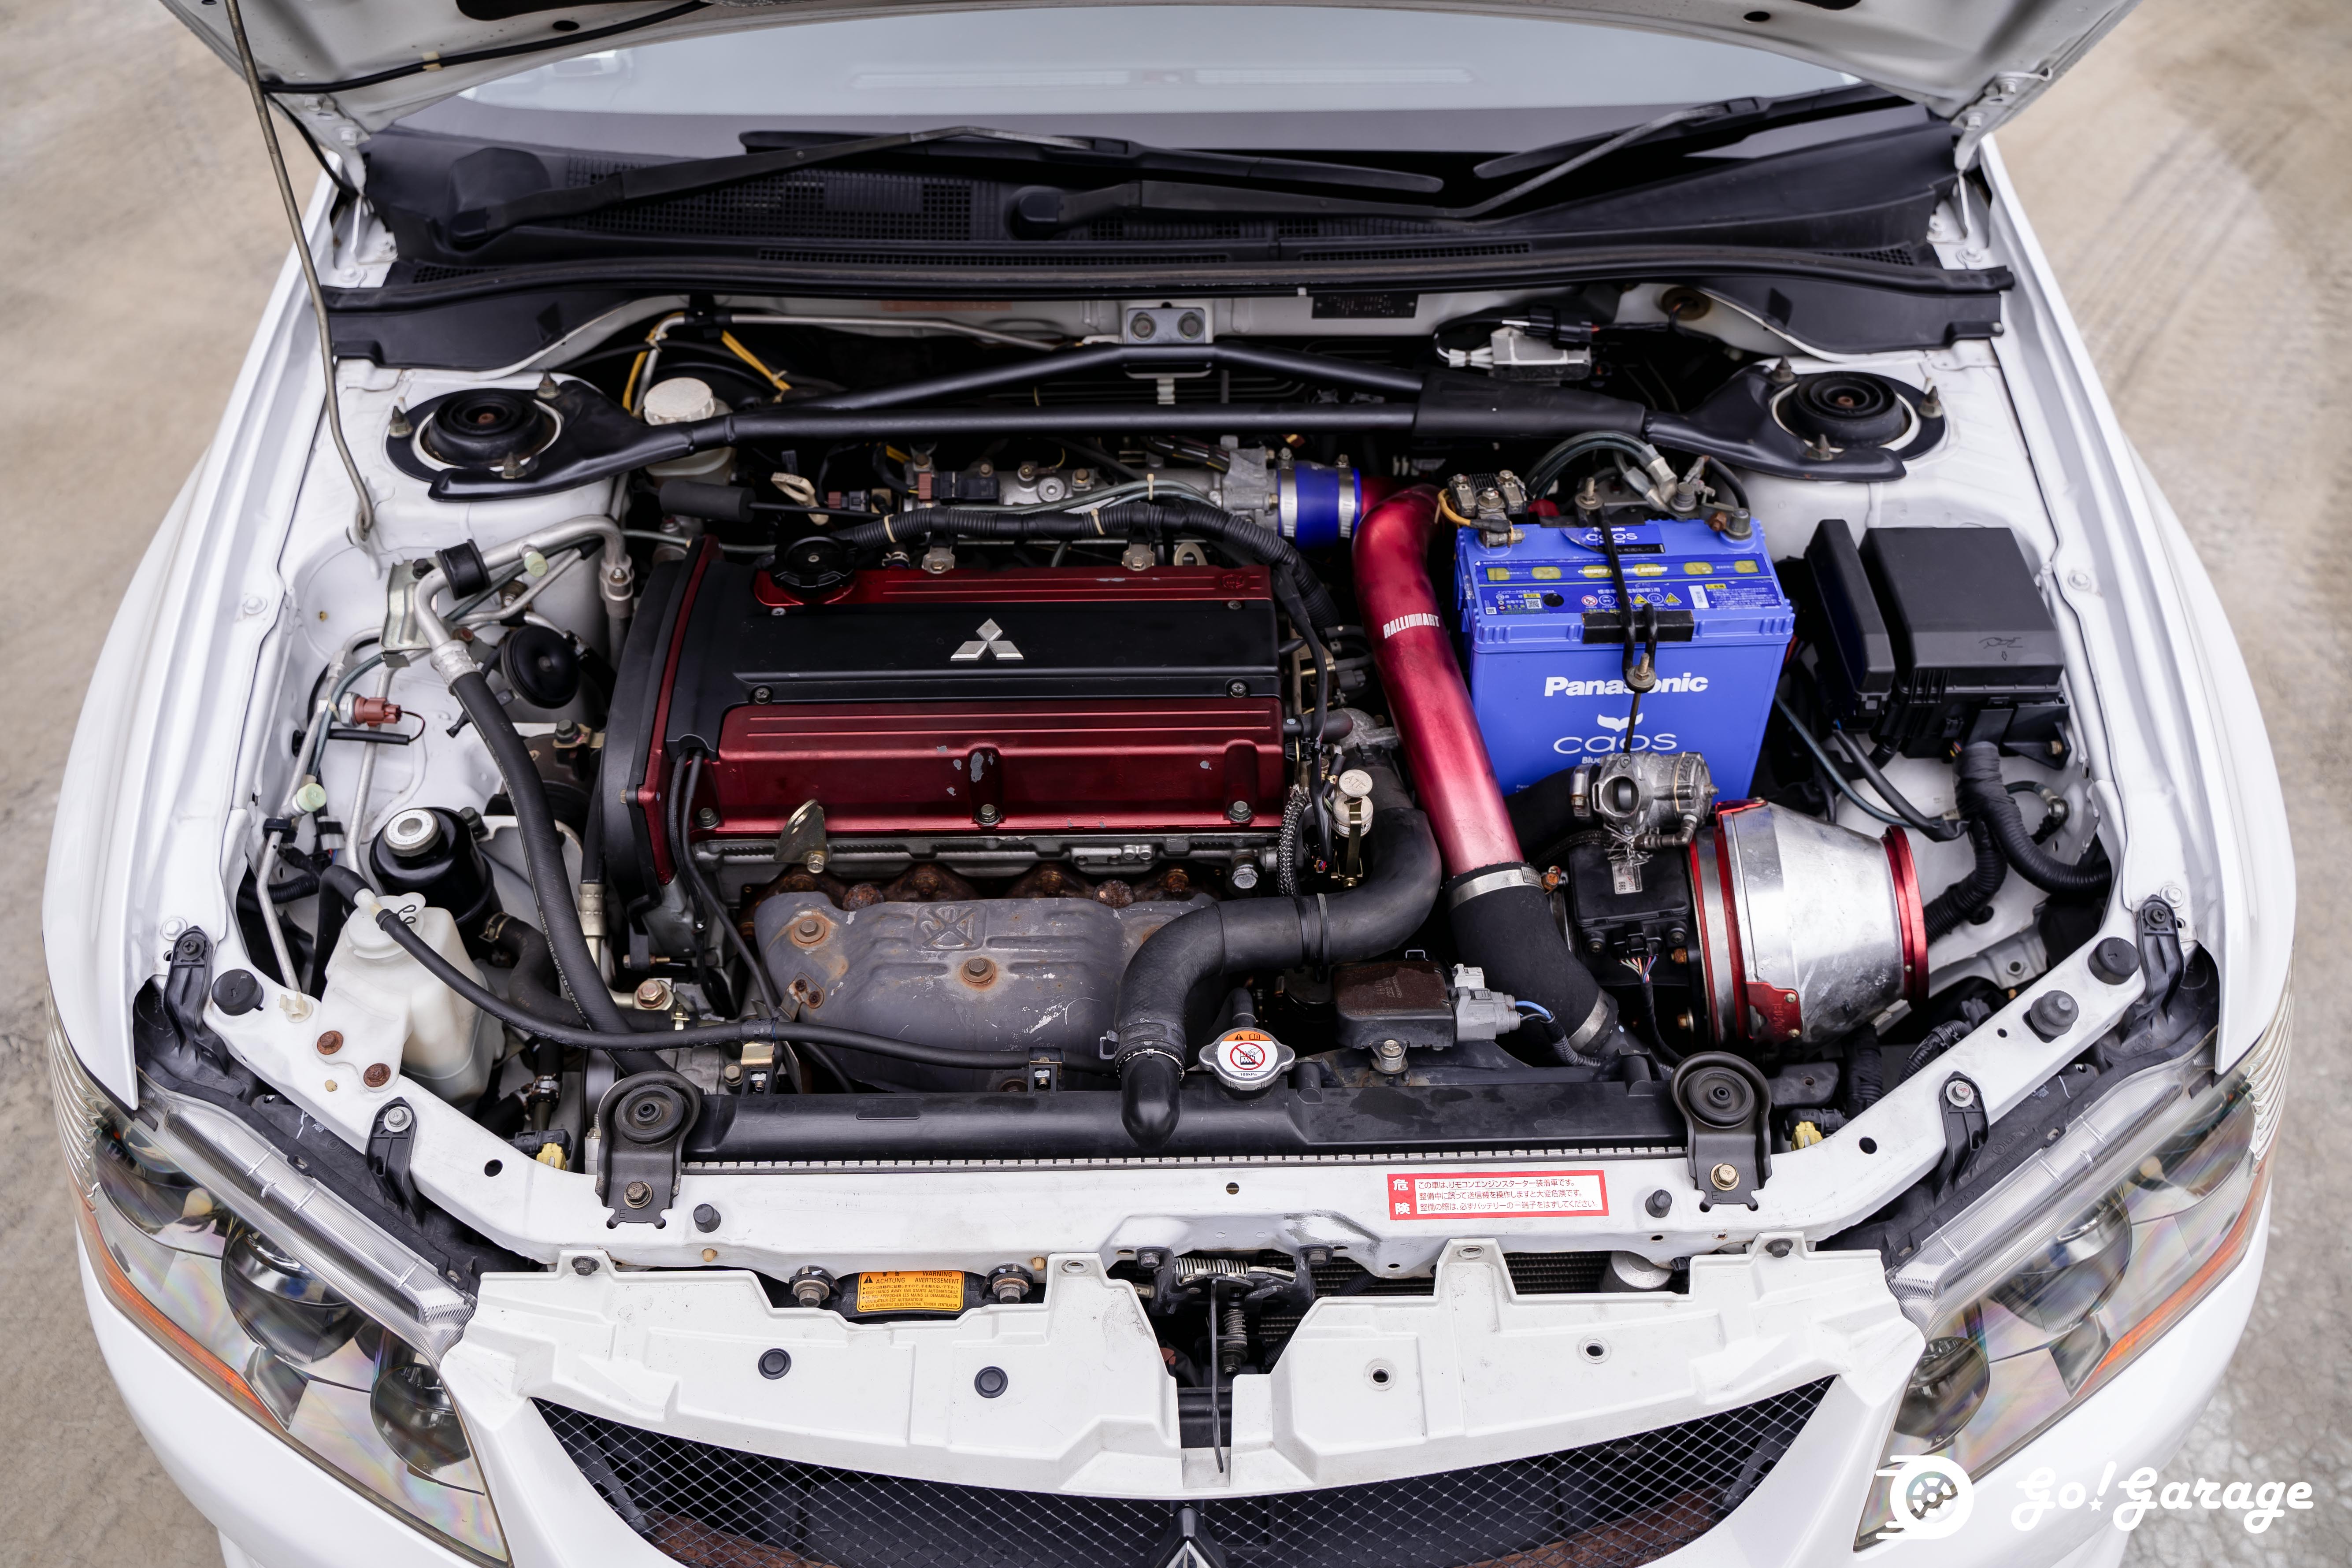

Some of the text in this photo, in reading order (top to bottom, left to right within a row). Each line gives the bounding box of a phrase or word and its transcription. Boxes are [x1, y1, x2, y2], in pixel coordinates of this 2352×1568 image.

[1553, 733, 1677, 754] caos
[1418, 1179, 1574, 1189] この車は、リモコンエンジンスターター装着車です。
[1419, 1190, 1582, 1200] 整備中に誤って送信機を操作しますと大変危険です。
[619, 1209, 627, 1219] E
